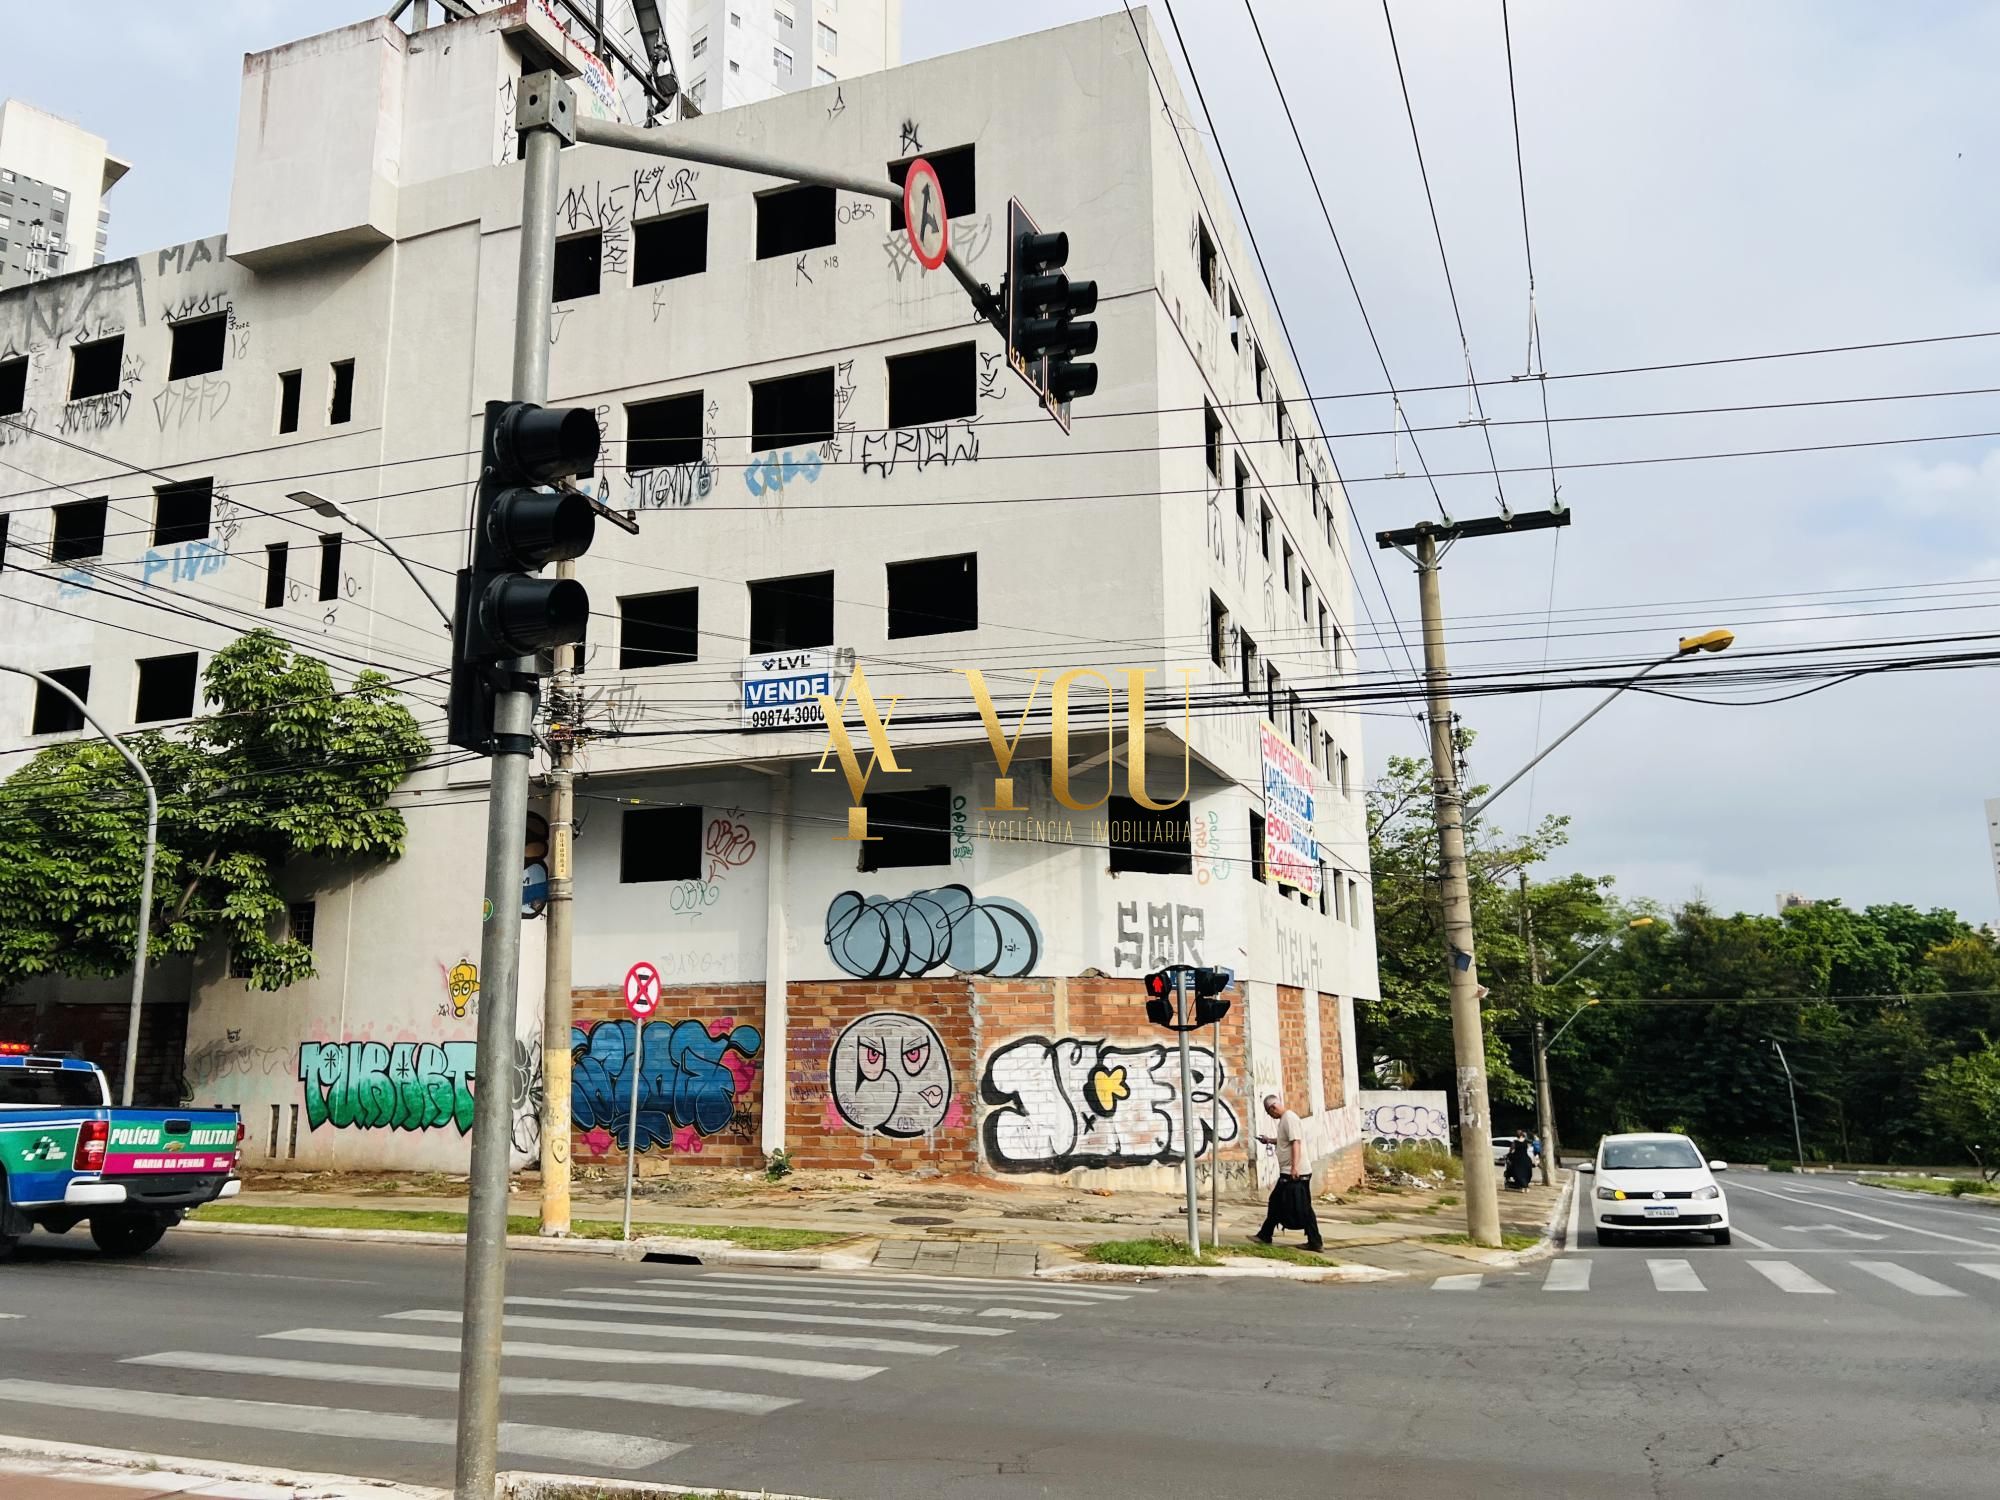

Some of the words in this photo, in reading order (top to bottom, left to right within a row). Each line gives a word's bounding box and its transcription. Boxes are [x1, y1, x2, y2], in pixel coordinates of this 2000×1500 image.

[778, 655, 810, 670] LVL
[748, 678, 825, 705] VENDE
[752, 705, 825, 728] 99874-3000
[110, 1127, 160, 1145] POLÍCIA
[190, 1129, 235, 1146] MILITAR
[133, 1158, 163, 1169] MARIA
